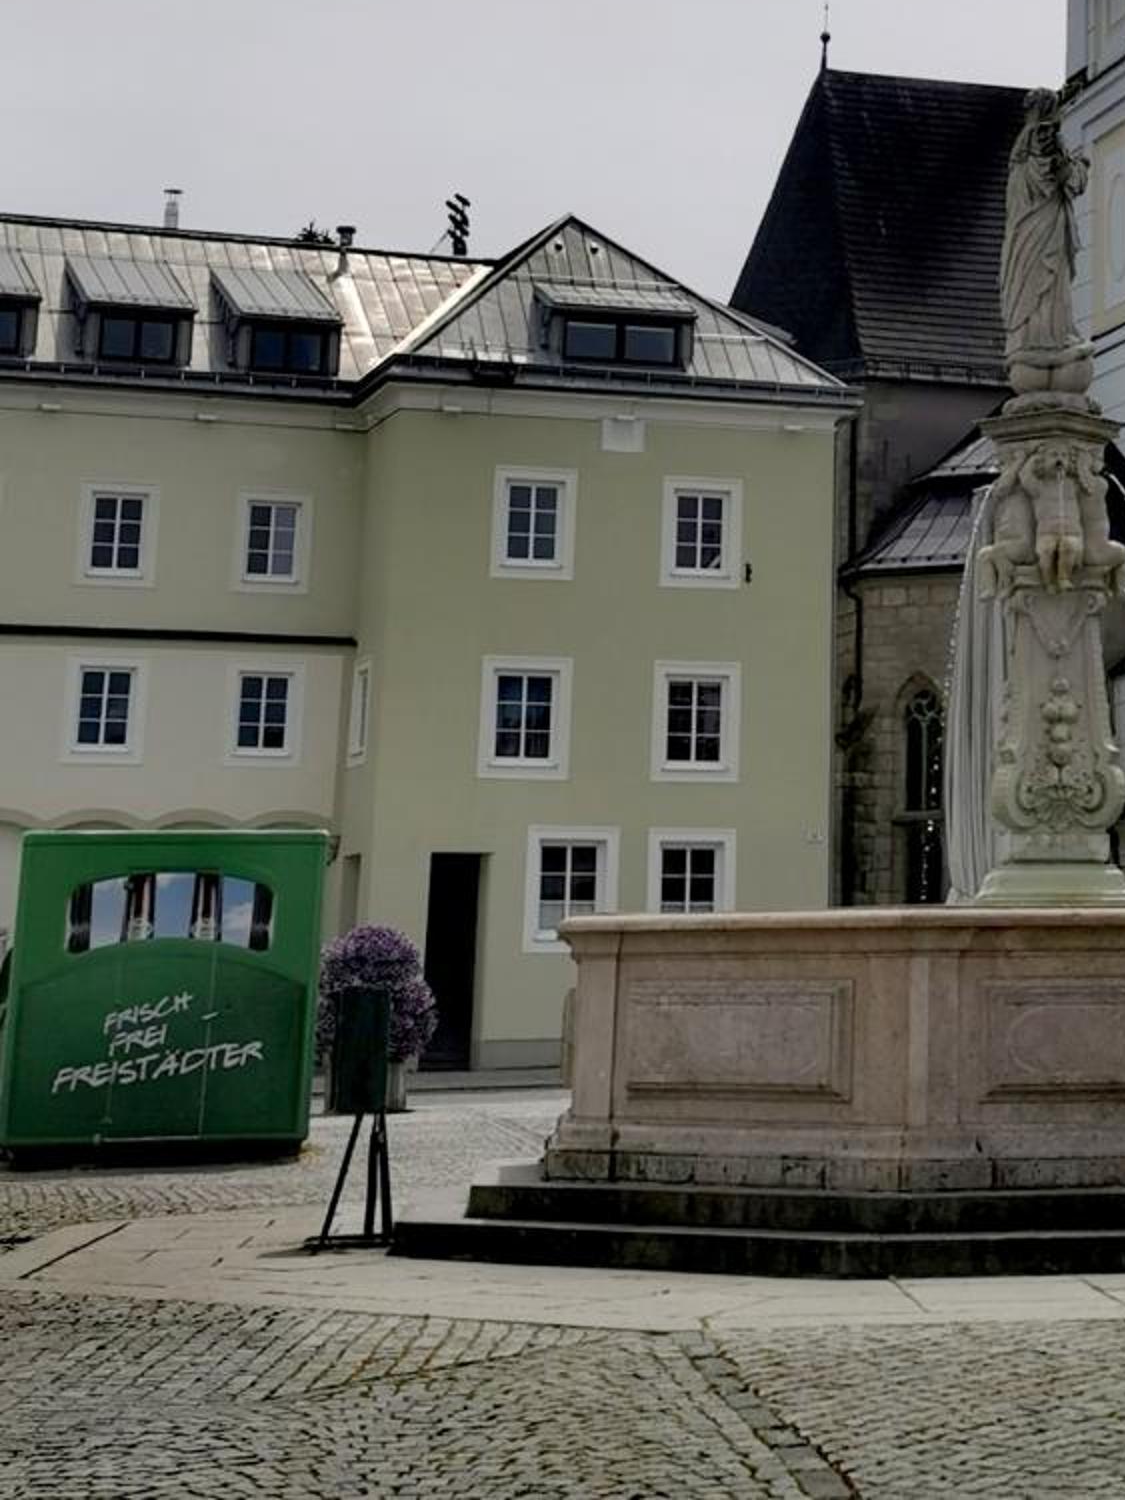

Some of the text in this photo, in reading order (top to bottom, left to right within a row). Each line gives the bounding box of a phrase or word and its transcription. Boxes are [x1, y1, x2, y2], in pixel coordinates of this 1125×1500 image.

[103, 990, 193, 1035] FRISCH
[108, 1023, 168, 1057] FREI
[51, 1041, 264, 1094] FREISTÄDTER
